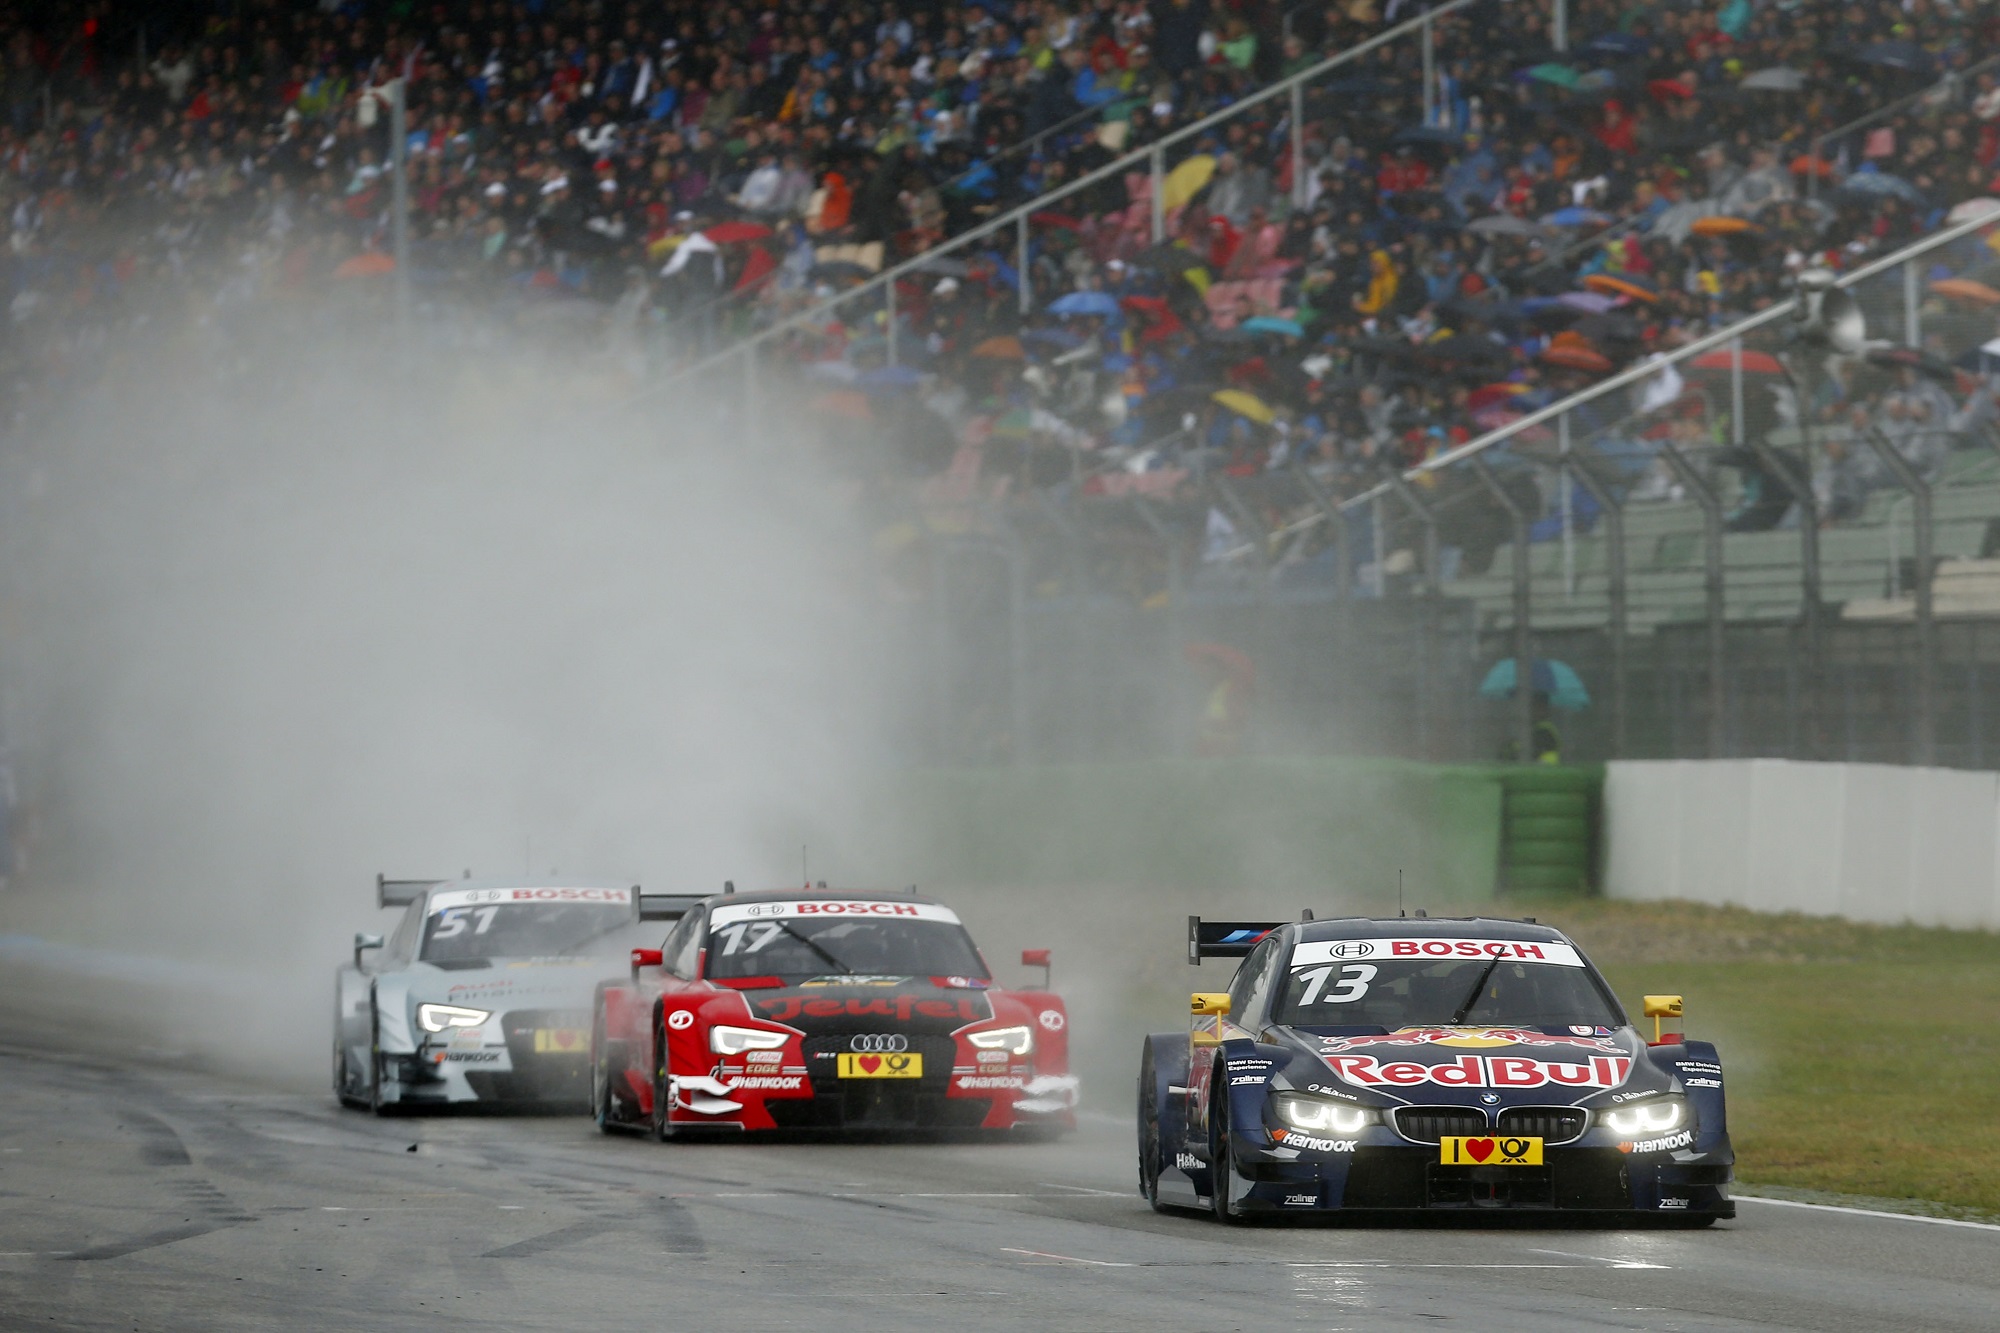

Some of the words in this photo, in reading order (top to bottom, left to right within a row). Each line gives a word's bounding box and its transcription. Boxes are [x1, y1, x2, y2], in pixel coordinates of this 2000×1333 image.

[512, 888, 626, 901] BOSCH
[797, 903, 919, 916] BOSCH
[433, 906, 499, 939] 51
[719, 921, 788, 956] 17
[1391, 941, 1545, 960] BOSCH
[1298, 965, 1378, 1007] 13
[758, 994, 980, 1021] Teufel
[745, 1064, 779, 1074] EDGE
[1323, 1055, 1487, 1088] Red
[1486, 1055, 1632, 1089] Bull
[1453, 1139, 1459, 1162] I
